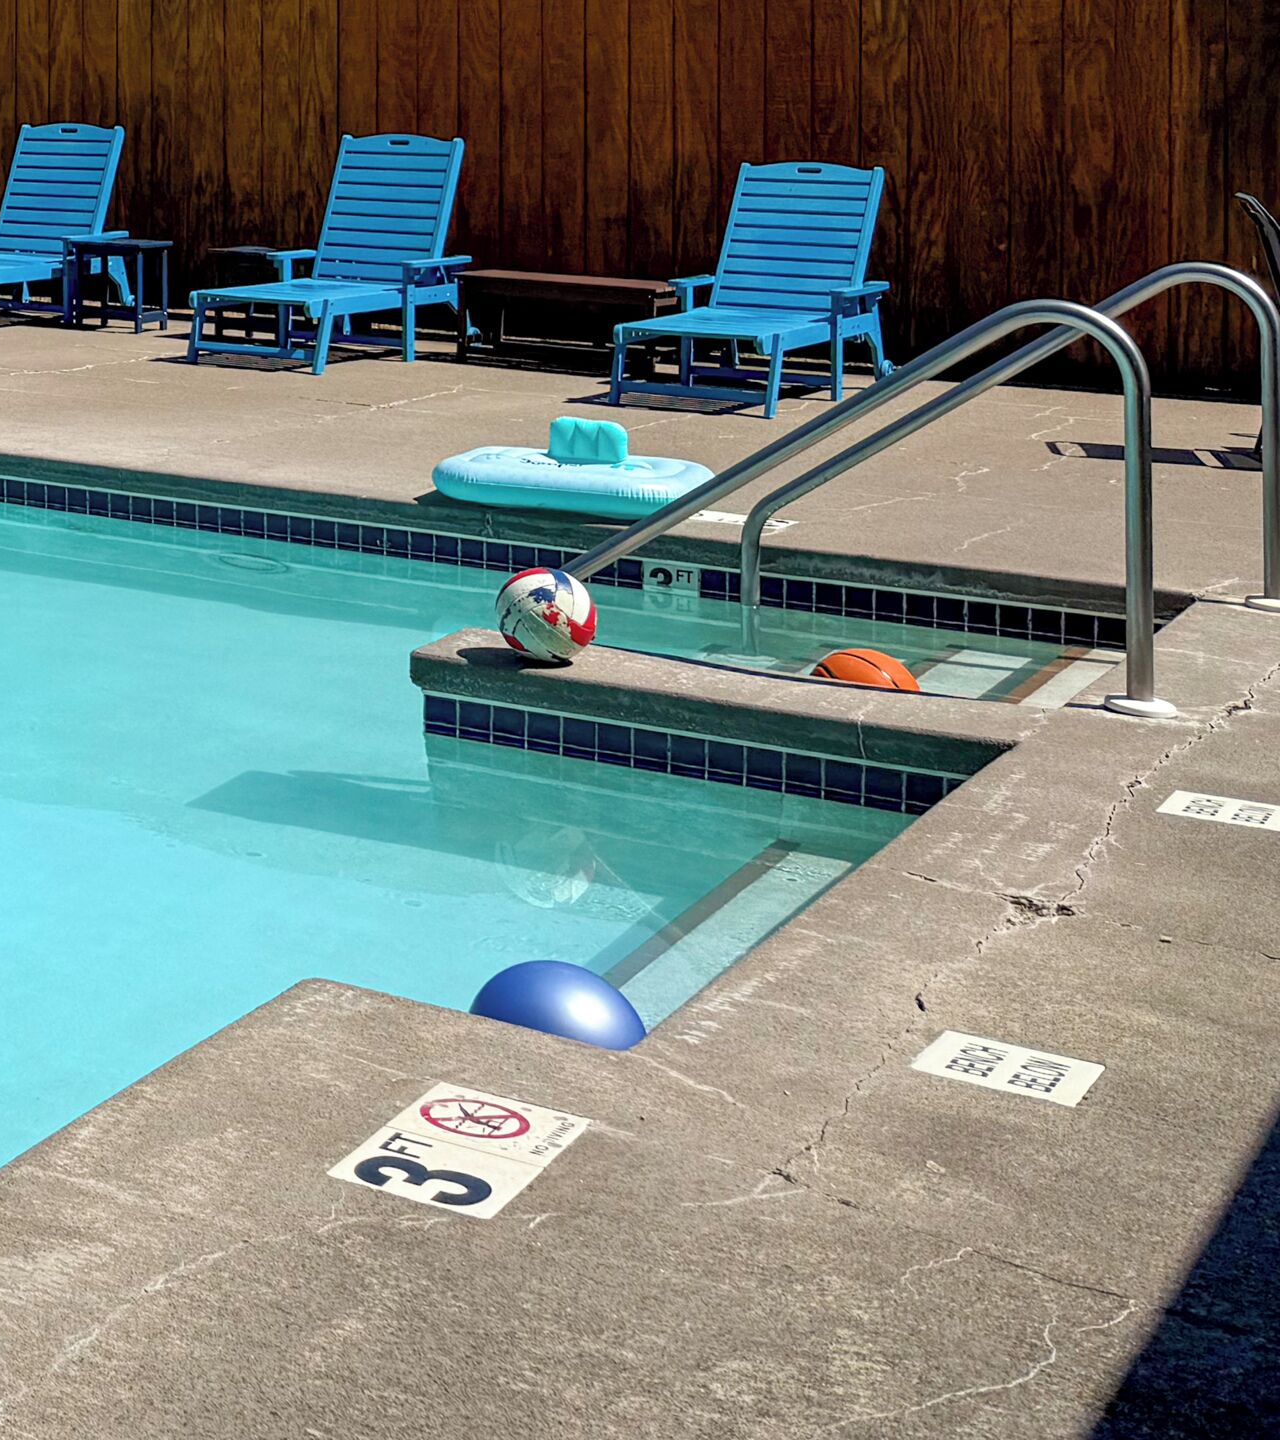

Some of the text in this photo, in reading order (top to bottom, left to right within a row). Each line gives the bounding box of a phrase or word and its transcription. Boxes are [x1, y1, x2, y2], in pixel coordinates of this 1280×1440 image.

[676, 569, 694, 584] FT
[944, 1042, 1009, 1078] BENCH
[1007, 1055, 1072, 1093] BELOW
[529, 1144, 549, 1157] NO
[353, 1132, 493, 1207] 3 FT
